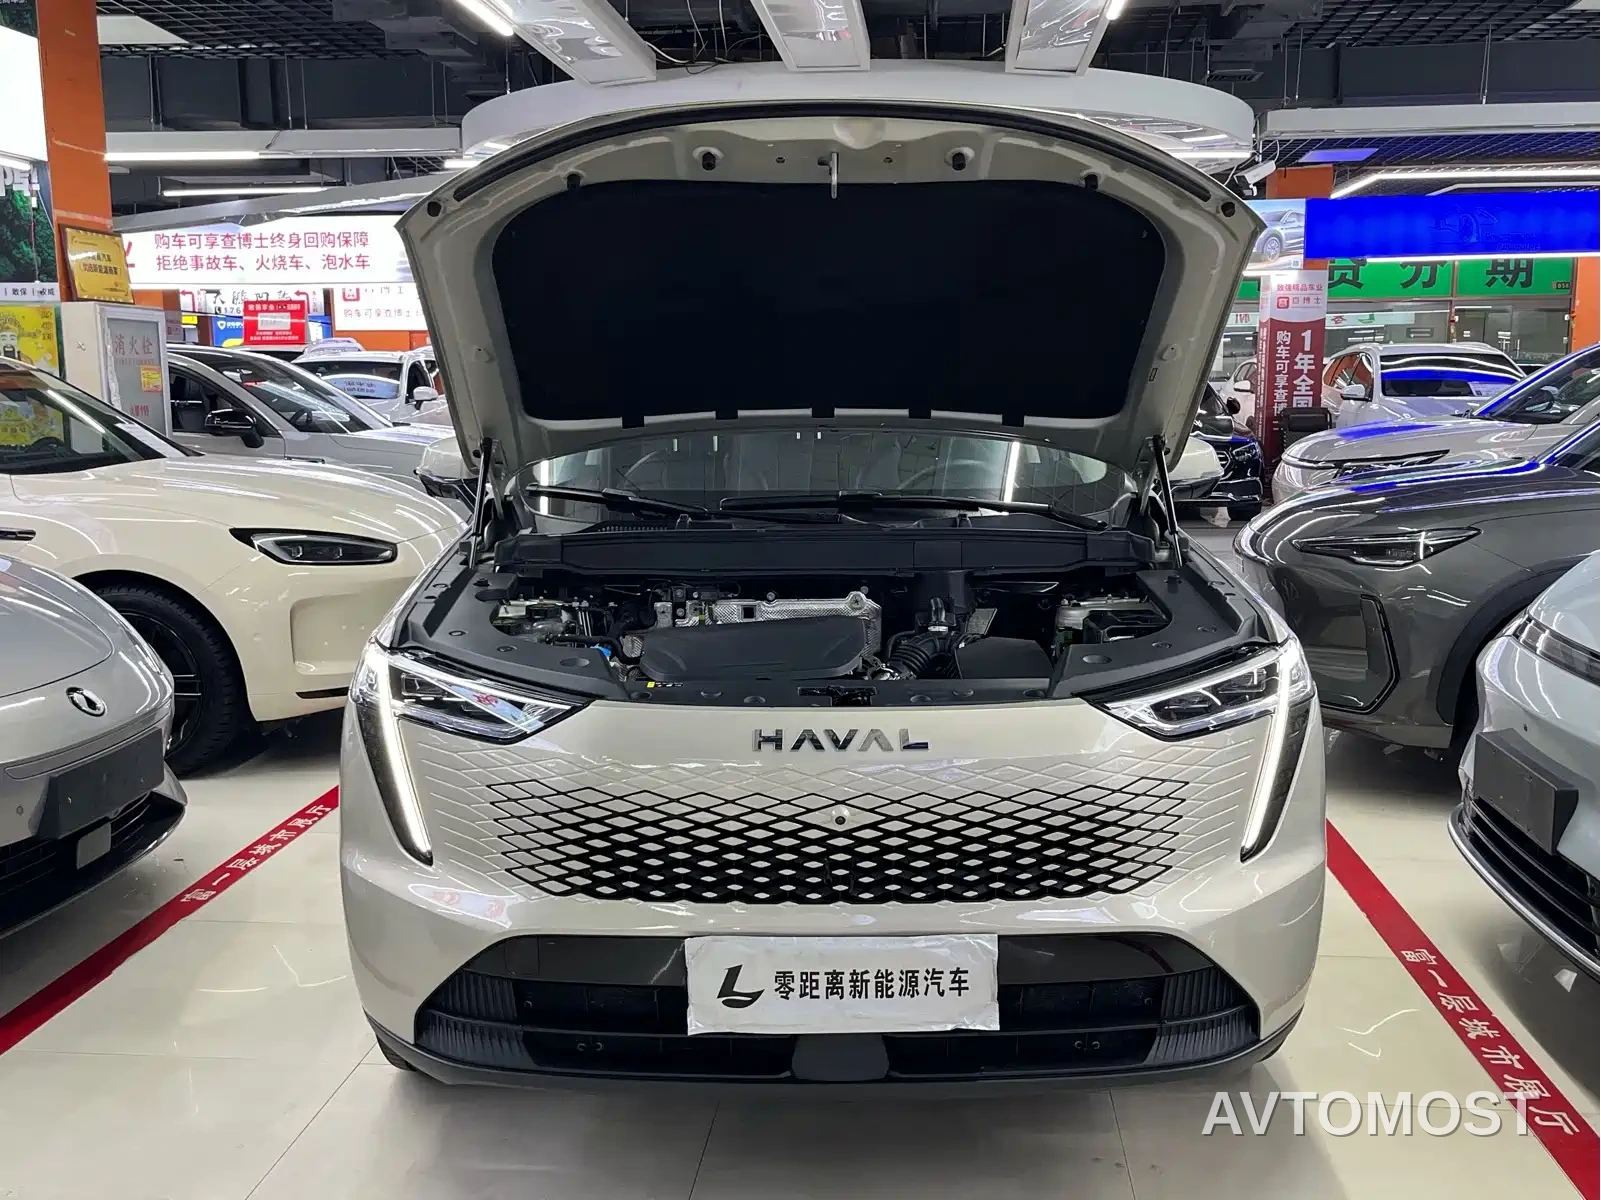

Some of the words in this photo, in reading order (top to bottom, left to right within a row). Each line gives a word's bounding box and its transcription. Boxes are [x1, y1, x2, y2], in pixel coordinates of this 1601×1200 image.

[154, 231, 370, 249] 购车可享查博士终身回购保障
[156, 254, 371, 272] 拒绝事故车、火烧车、泡水车
[114, 332, 153, 357] 消火栓
[752, 728, 930, 752] HAVAL
[774, 966, 970, 1001] 零距离新能源汽车
